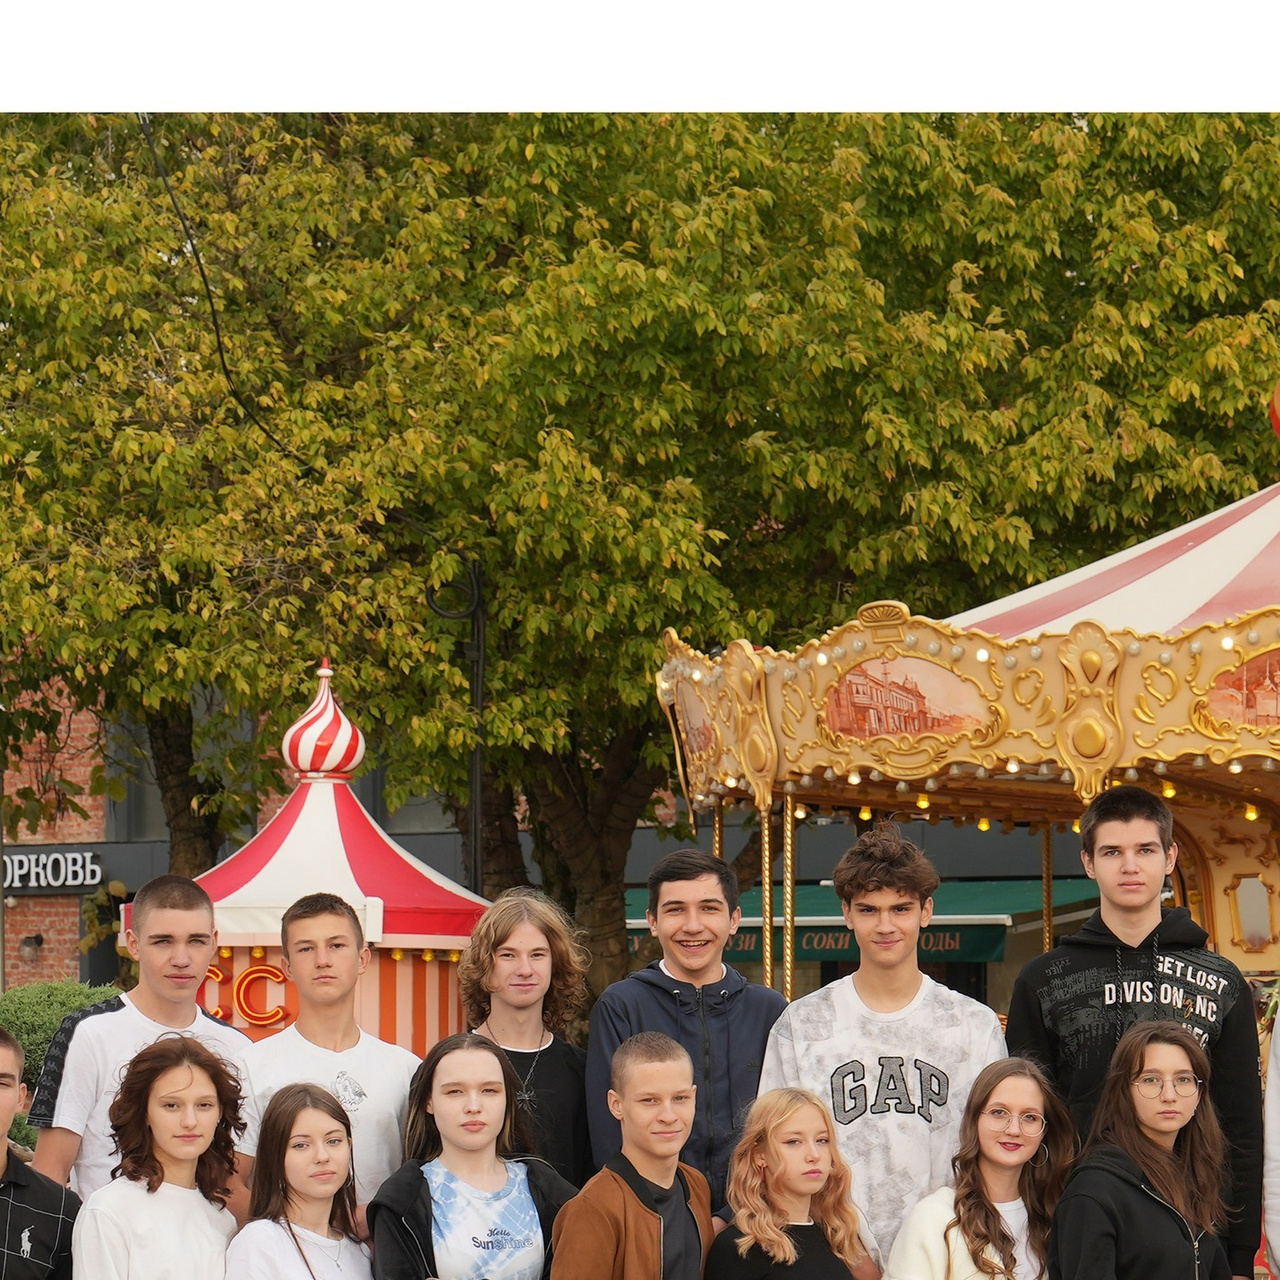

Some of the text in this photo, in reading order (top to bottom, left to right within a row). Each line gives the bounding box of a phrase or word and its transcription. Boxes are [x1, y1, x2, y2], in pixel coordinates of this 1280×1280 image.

[725, 931, 960, 952] УЗИ СОКИ ОДЫ
[1156, 955, 1184, 978] GET
[1186, 966, 1228, 995] LOST
[1104, 981, 1184, 1009] DVISON
[1189, 994, 1217, 1022] NC
[831, 1056, 950, 1126] GAP
[471, 1236, 534, 1251] Sunshine
[487, 1228, 511, 1237] Hello
